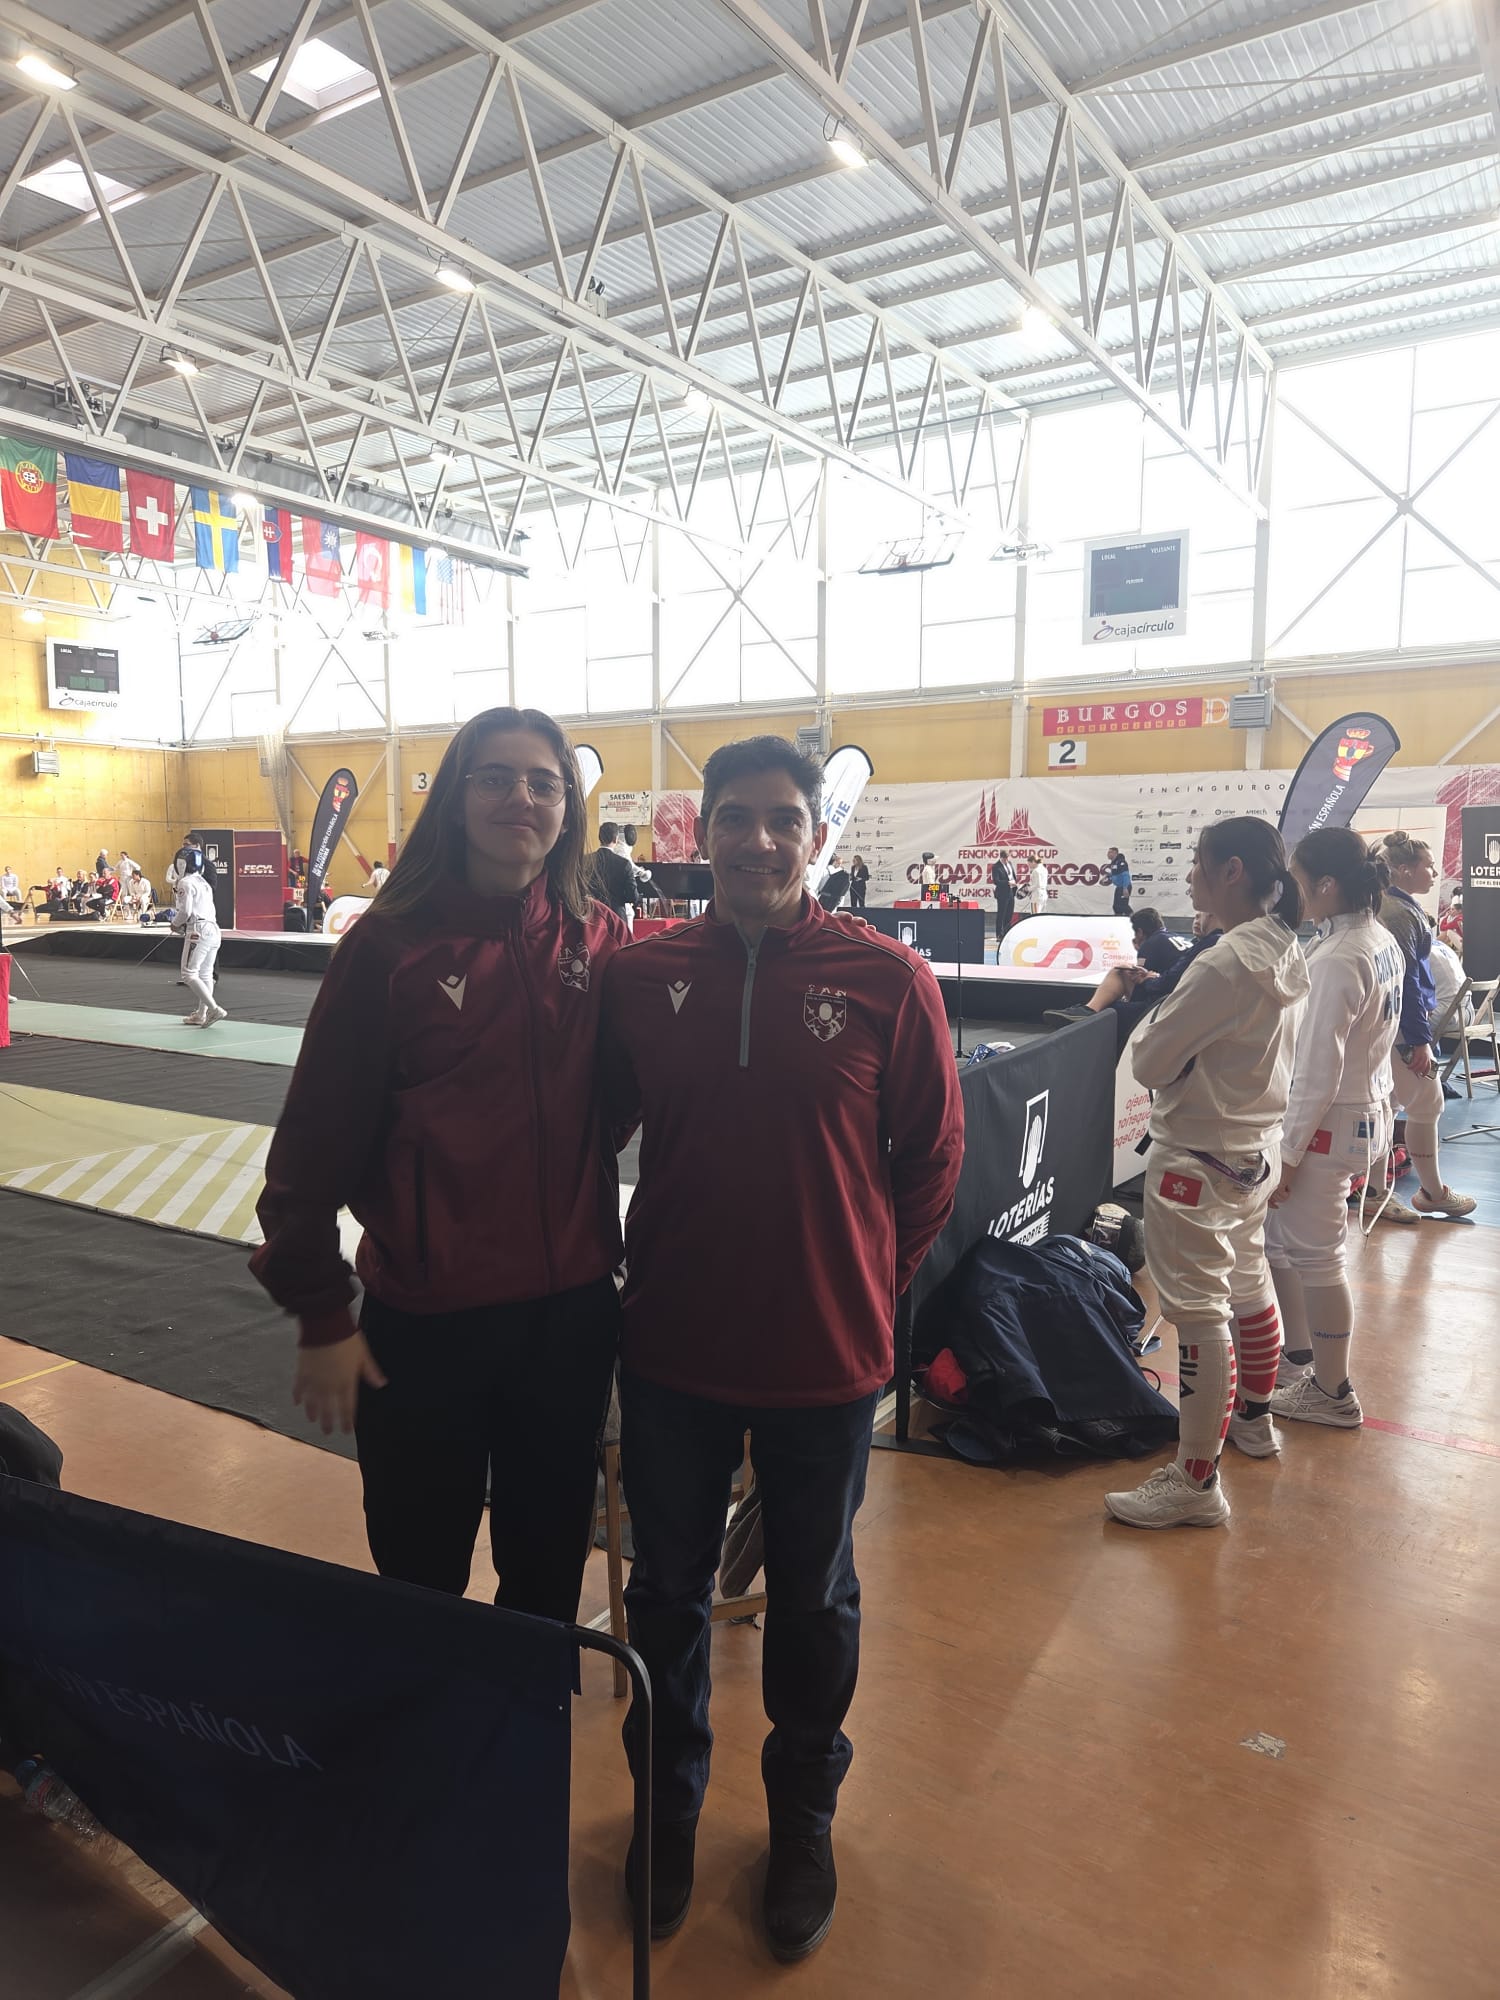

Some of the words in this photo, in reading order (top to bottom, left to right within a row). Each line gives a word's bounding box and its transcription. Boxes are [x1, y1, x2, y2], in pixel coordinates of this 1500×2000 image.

[1114, 620, 1174, 637] cajacírculo
[1057, 700, 1187, 724] BURGOS
[1059, 739, 1076, 764] 2
[418, 772, 427, 790] 3
[1139, 783, 1285, 794] FENCINGBURGO
[831, 800, 851, 827] FIE
[1316, 784, 1346, 823] ESPAÑOLA
[958, 850, 999, 859] FENCING
[1010, 850, 1036, 859] ORLD
[1037, 849, 1059, 859] CUP
[1015, 863, 1112, 886] BRGOS
[1470, 866, 1500, 876] LOTER
[957, 888, 992, 898] JUNIOR
[97, 1680, 324, 1772] ESPAÑOLA
